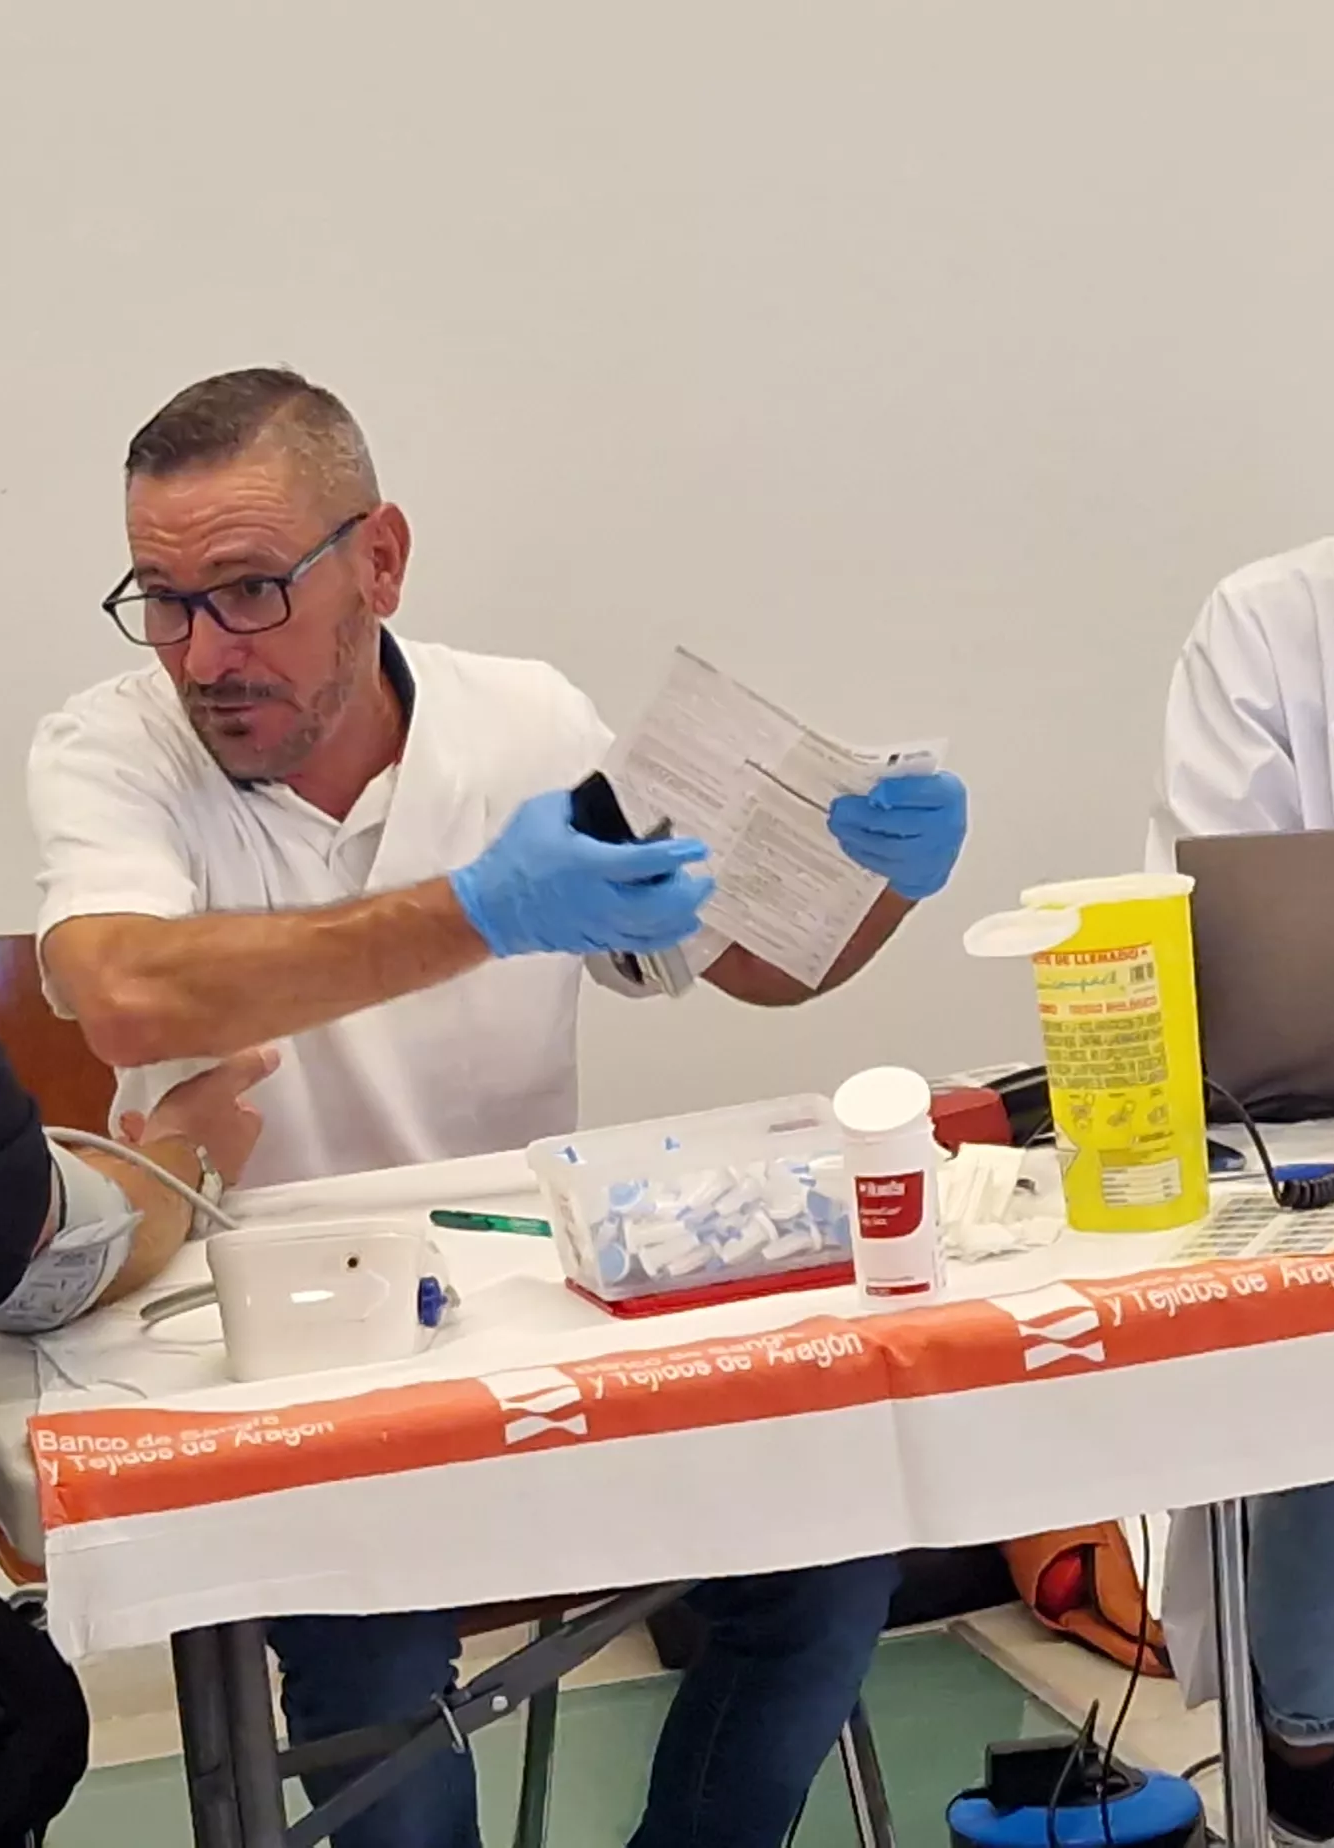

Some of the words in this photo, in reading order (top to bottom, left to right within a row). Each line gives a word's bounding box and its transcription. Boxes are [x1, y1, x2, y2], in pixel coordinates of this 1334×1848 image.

[1131, 1280, 1228, 1317] Tejidos
[37, 1429, 129, 1452] Banco
[136, 1432, 172, 1449] de
[39, 1455, 60, 1486] y
[67, 1447, 174, 1476] Tejidos
